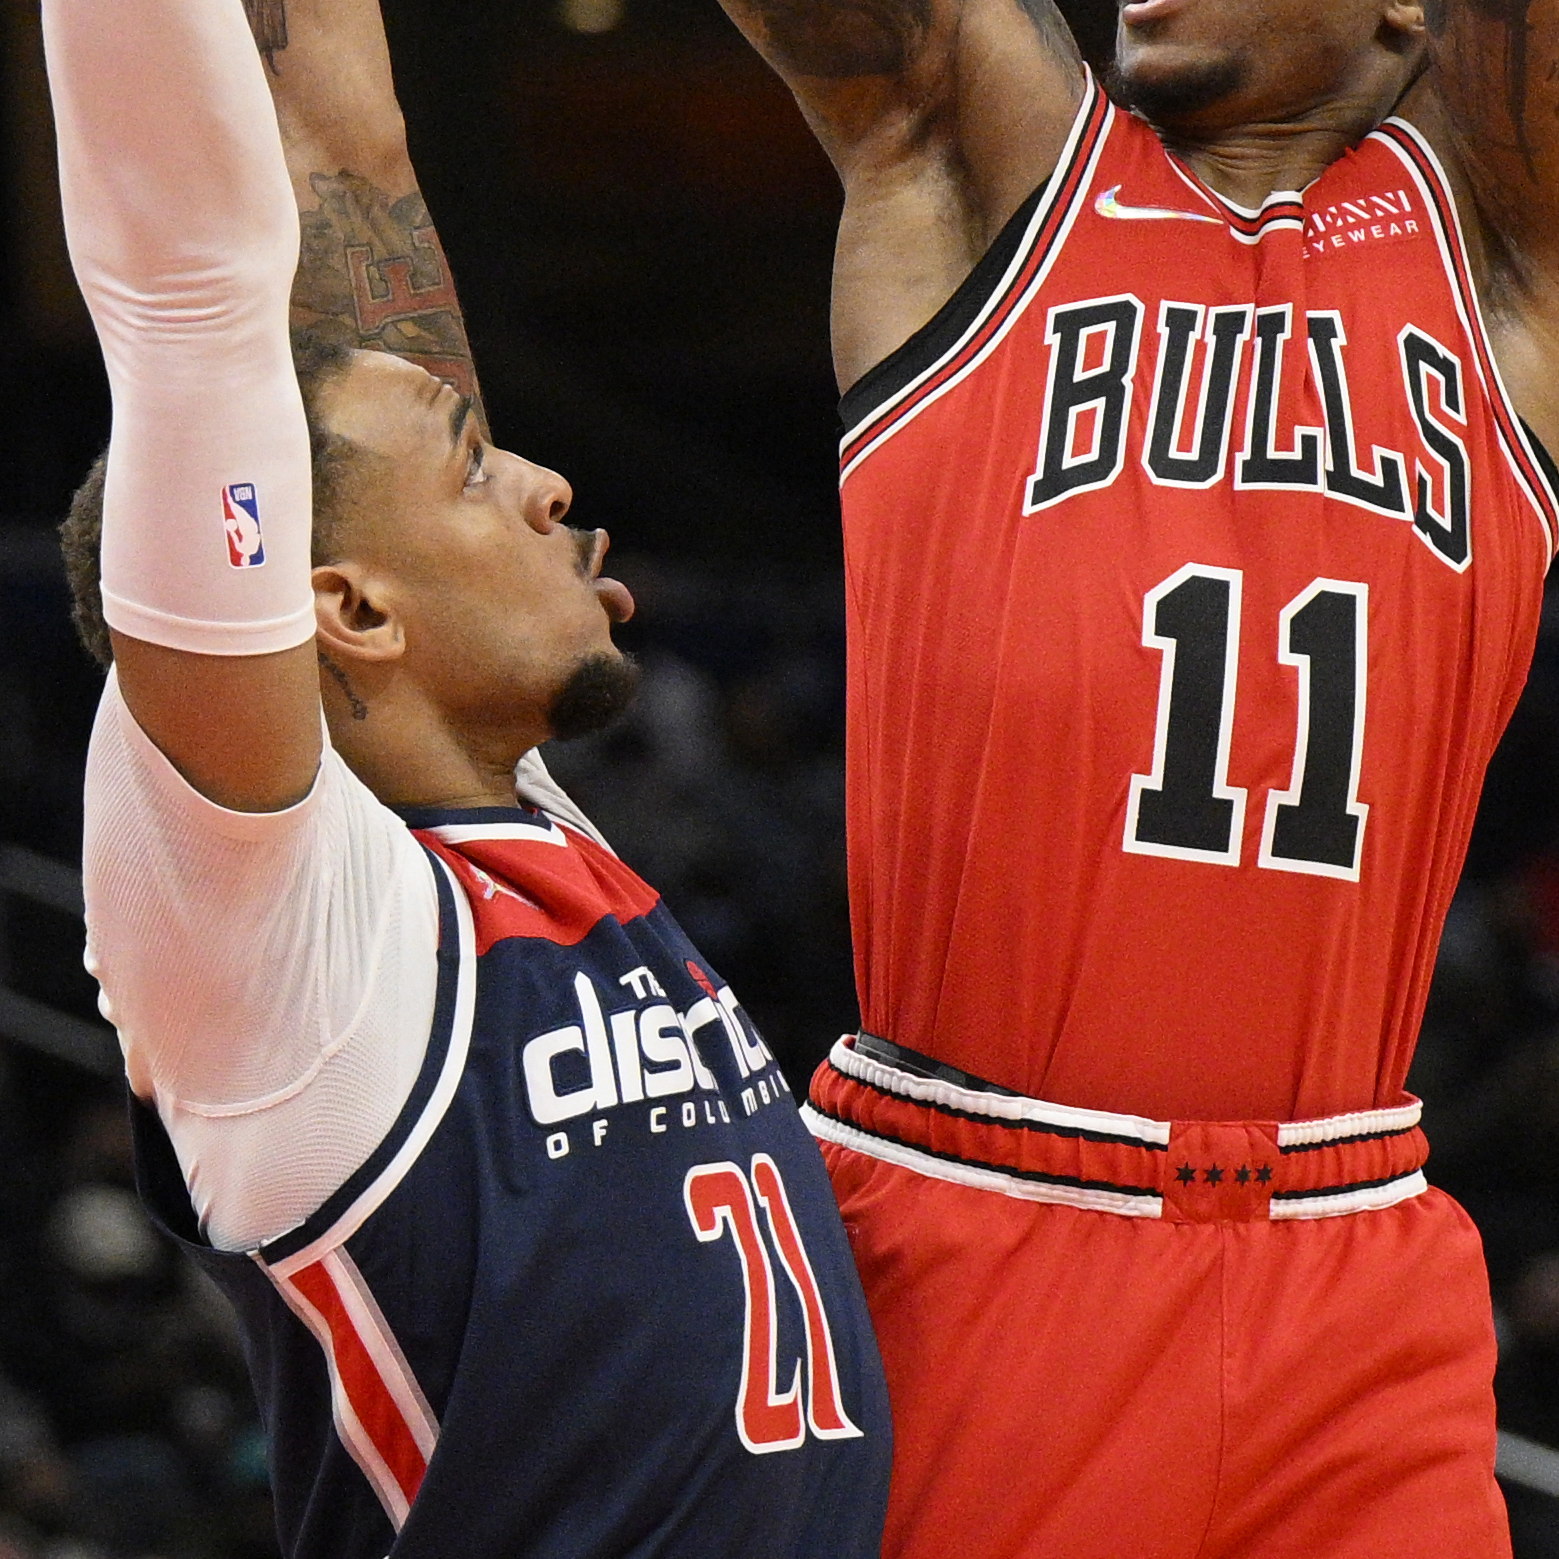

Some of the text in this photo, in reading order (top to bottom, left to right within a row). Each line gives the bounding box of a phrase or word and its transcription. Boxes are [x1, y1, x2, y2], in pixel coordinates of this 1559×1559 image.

[1307, 190, 1412, 238] ENNI
[1022, 292, 1472, 574] BULLS
[1122, 562, 1369, 883] 11
[545, 1119, 609, 1160] OF
[683, 1153, 864, 1454] 21
